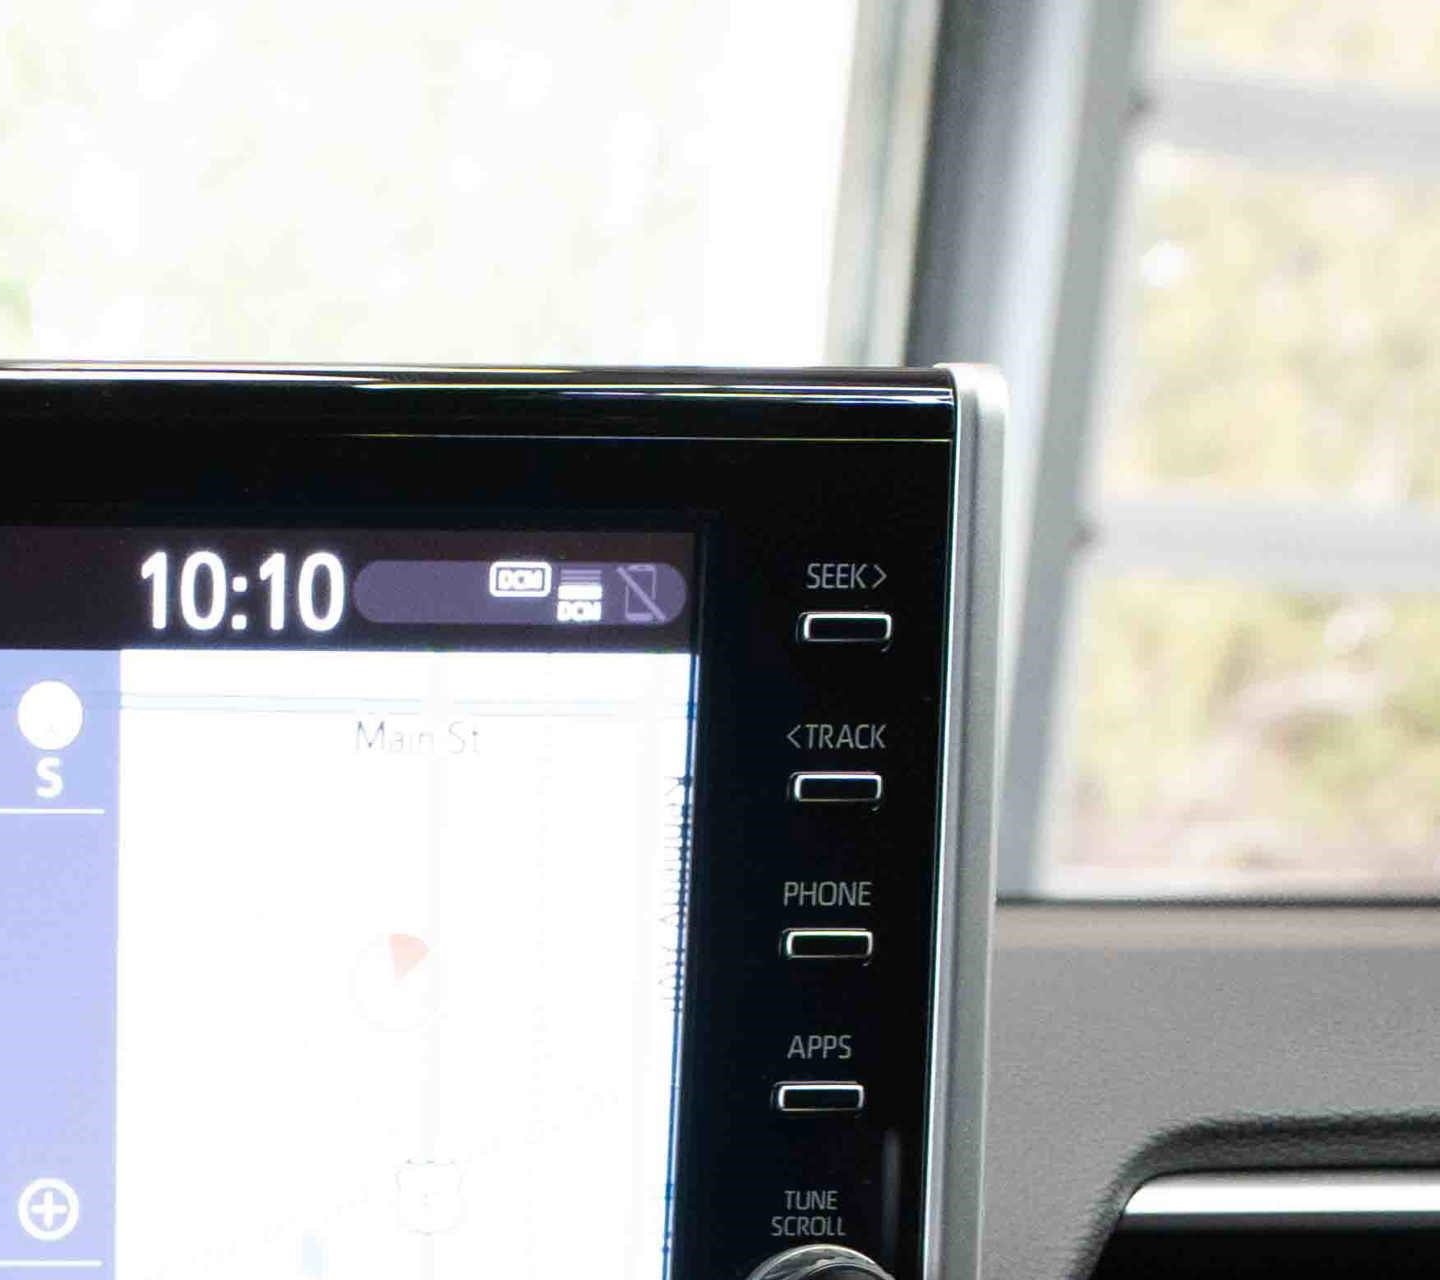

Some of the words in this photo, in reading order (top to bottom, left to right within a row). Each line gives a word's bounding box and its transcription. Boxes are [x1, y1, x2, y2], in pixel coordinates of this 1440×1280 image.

[140, 549, 346, 633] 10:10
[34, 754, 65, 801] S
[783, 880, 872, 907] PHONE
[786, 1034, 852, 1059] APPS
[784, 1190, 838, 1211] TUNE
[771, 1215, 846, 1237] SCROLL
